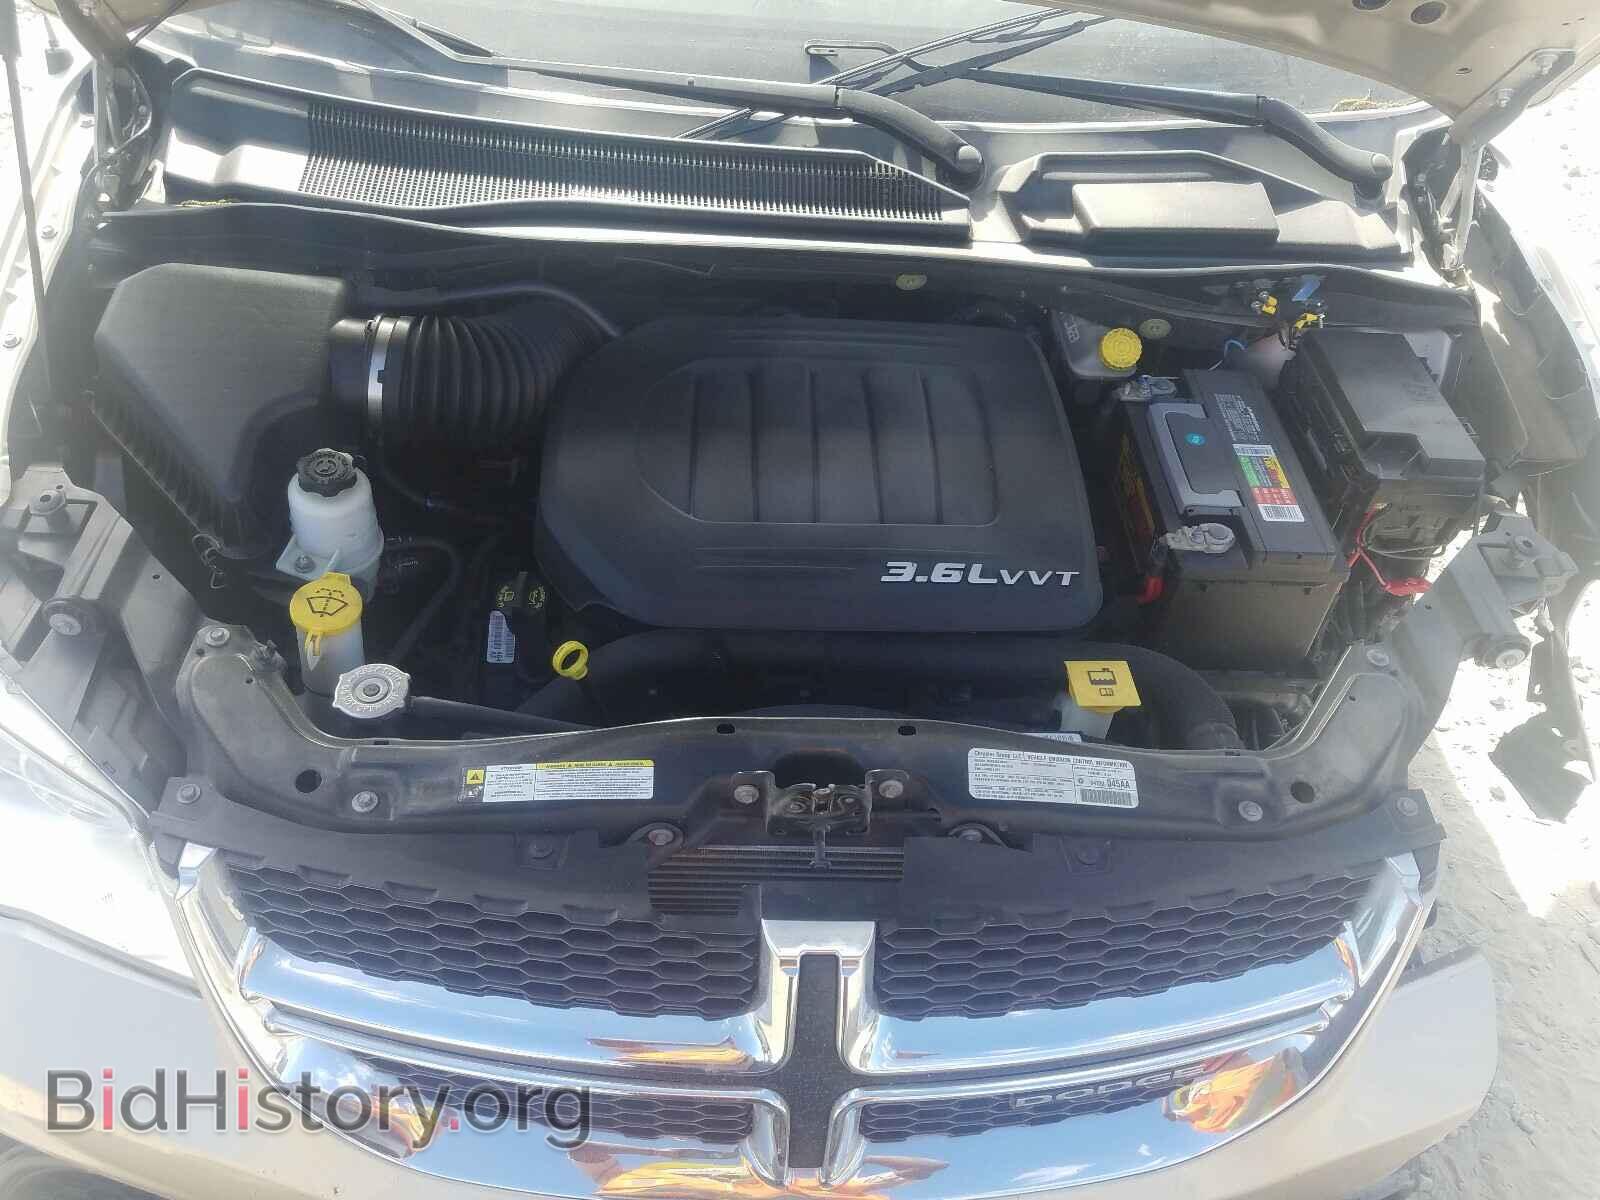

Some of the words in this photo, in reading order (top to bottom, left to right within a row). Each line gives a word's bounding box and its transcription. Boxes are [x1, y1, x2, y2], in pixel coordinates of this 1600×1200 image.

[880, 561, 998, 583] 3.6L
[1000, 569, 1080, 586] VVT
[1010, 1064, 1205, 1110] DODGE
